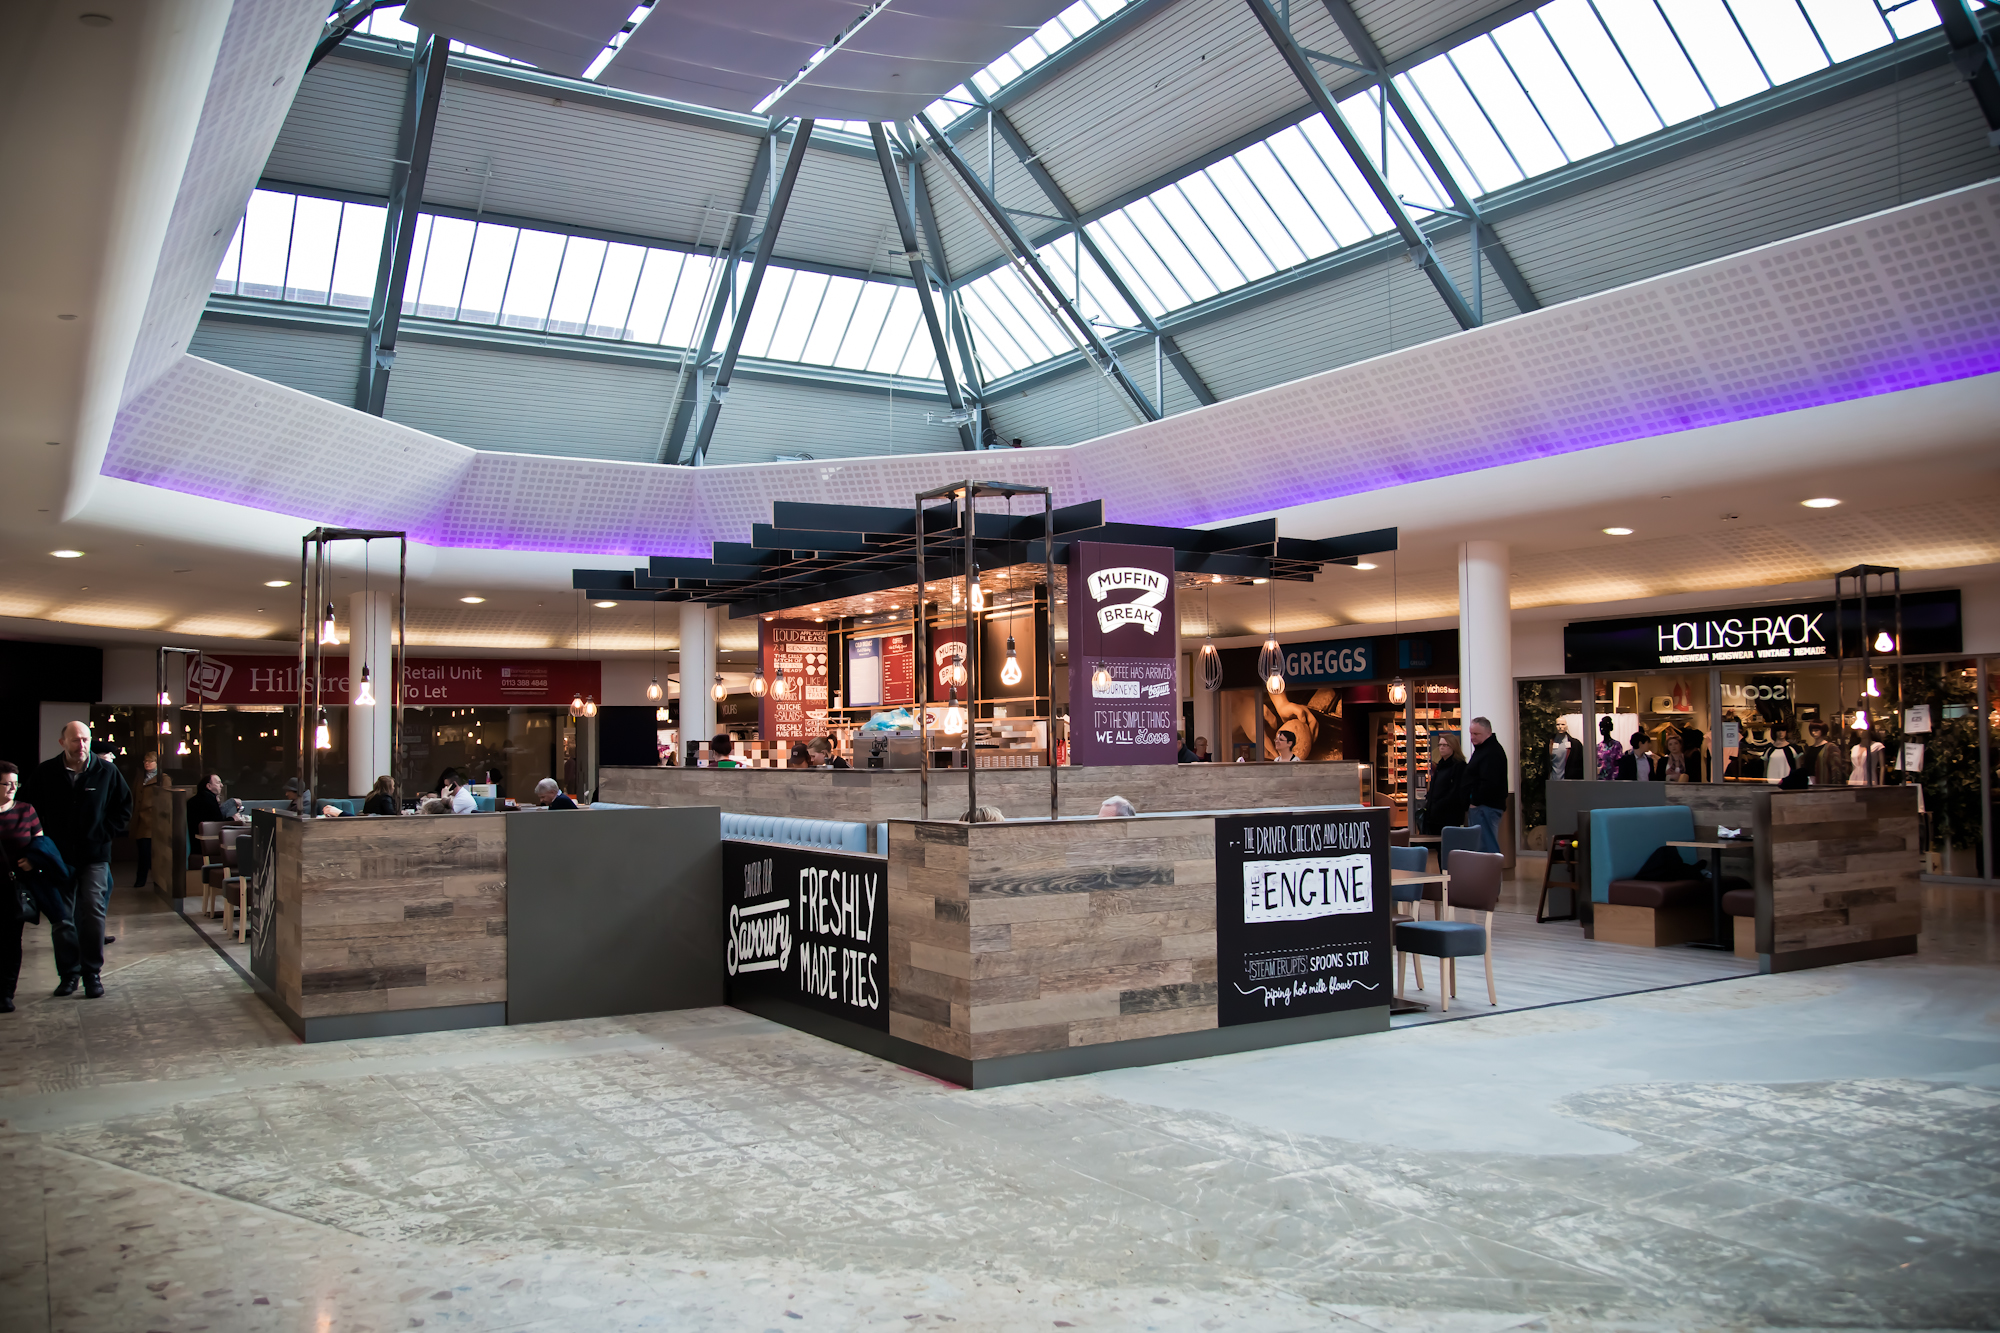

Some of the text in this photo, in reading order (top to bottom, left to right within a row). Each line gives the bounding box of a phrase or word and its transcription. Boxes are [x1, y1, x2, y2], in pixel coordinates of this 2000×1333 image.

[1098, 572, 1159, 588] MUFFIN
[1104, 608, 1154, 623] BREAK
[939, 644, 964, 657] MUFFIN
[1659, 646, 1826, 664] WOMENSWEAR MENSWEAR VINTAGE REMADE
[1286, 647, 1367, 676] GREGGS
[402, 665, 482, 680] Retail Unit
[1106, 666, 1129, 679] COFFEE
[1131, 667, 1144, 679] HAS
[1145, 667, 1172, 679] ARRIVED
[402, 685, 447, 698] To Let
[1148, 683, 1171, 698] begun
[722, 704, 738, 715] YOURS
[1095, 711, 1171, 728] IT'S THE SIMPLE THINGS
[1096, 728, 1170, 744] WE ALL Love
[1244, 821, 1371, 855] THE DRIVER CHECKS AND READIES
[763, 858, 773, 894] OUR
[1251, 865, 1365, 911] THE ENGINE
[800, 866, 878, 944] FRESHLY
[727, 904, 792, 976] Savoury
[1251, 958, 1276, 979] STEAM
[1310, 953, 1344, 972] SPOONS
[1346, 950, 1369, 967] STIR
[800, 941, 879, 1010] MADE PIES
[1264, 976, 1351, 1007] piping hot milk flows
